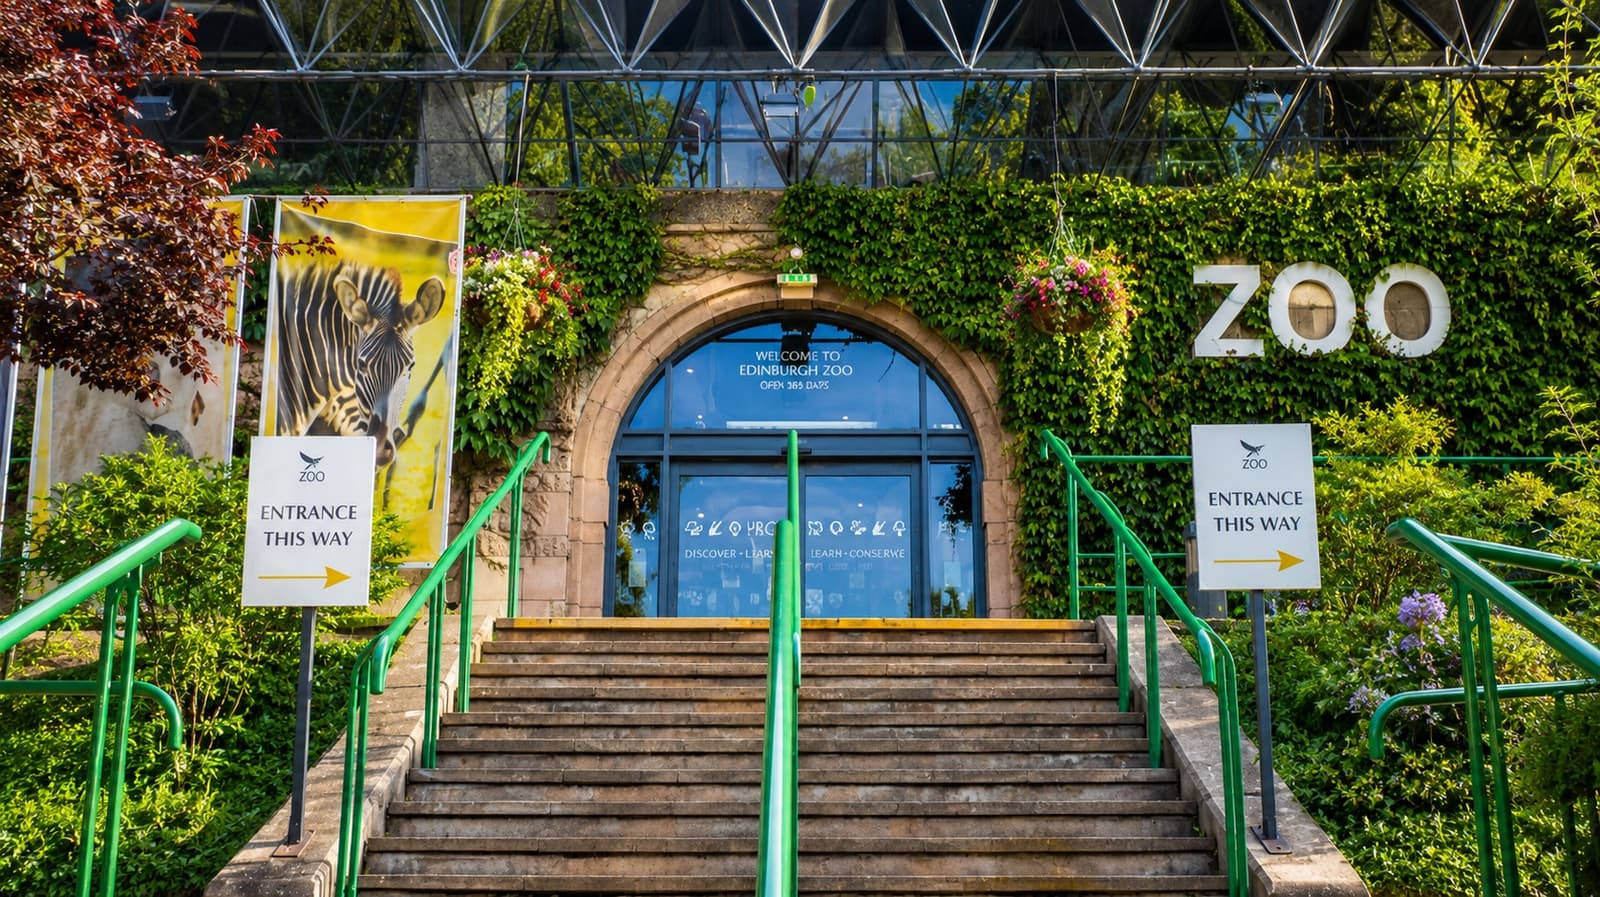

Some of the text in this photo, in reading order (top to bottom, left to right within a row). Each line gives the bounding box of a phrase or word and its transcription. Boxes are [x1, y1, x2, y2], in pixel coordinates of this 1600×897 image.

[1193, 261, 1451, 358] ZOO
[755, 351, 841, 361] WELCOME TO
[739, 364, 854, 376] EDINBURGH ZOO
[787, 381, 803, 390] 365
[1242, 458, 1268, 469] ZOO
[298, 471, 325, 482] ZOO
[1209, 491, 1303, 506] ENTRANCE
[261, 505, 357, 520] ENTRANCE
[1213, 516, 1301, 532] THIS WAY
[264, 531, 353, 546] THIS WAY
[684, 549, 736, 558] DISCOVER
